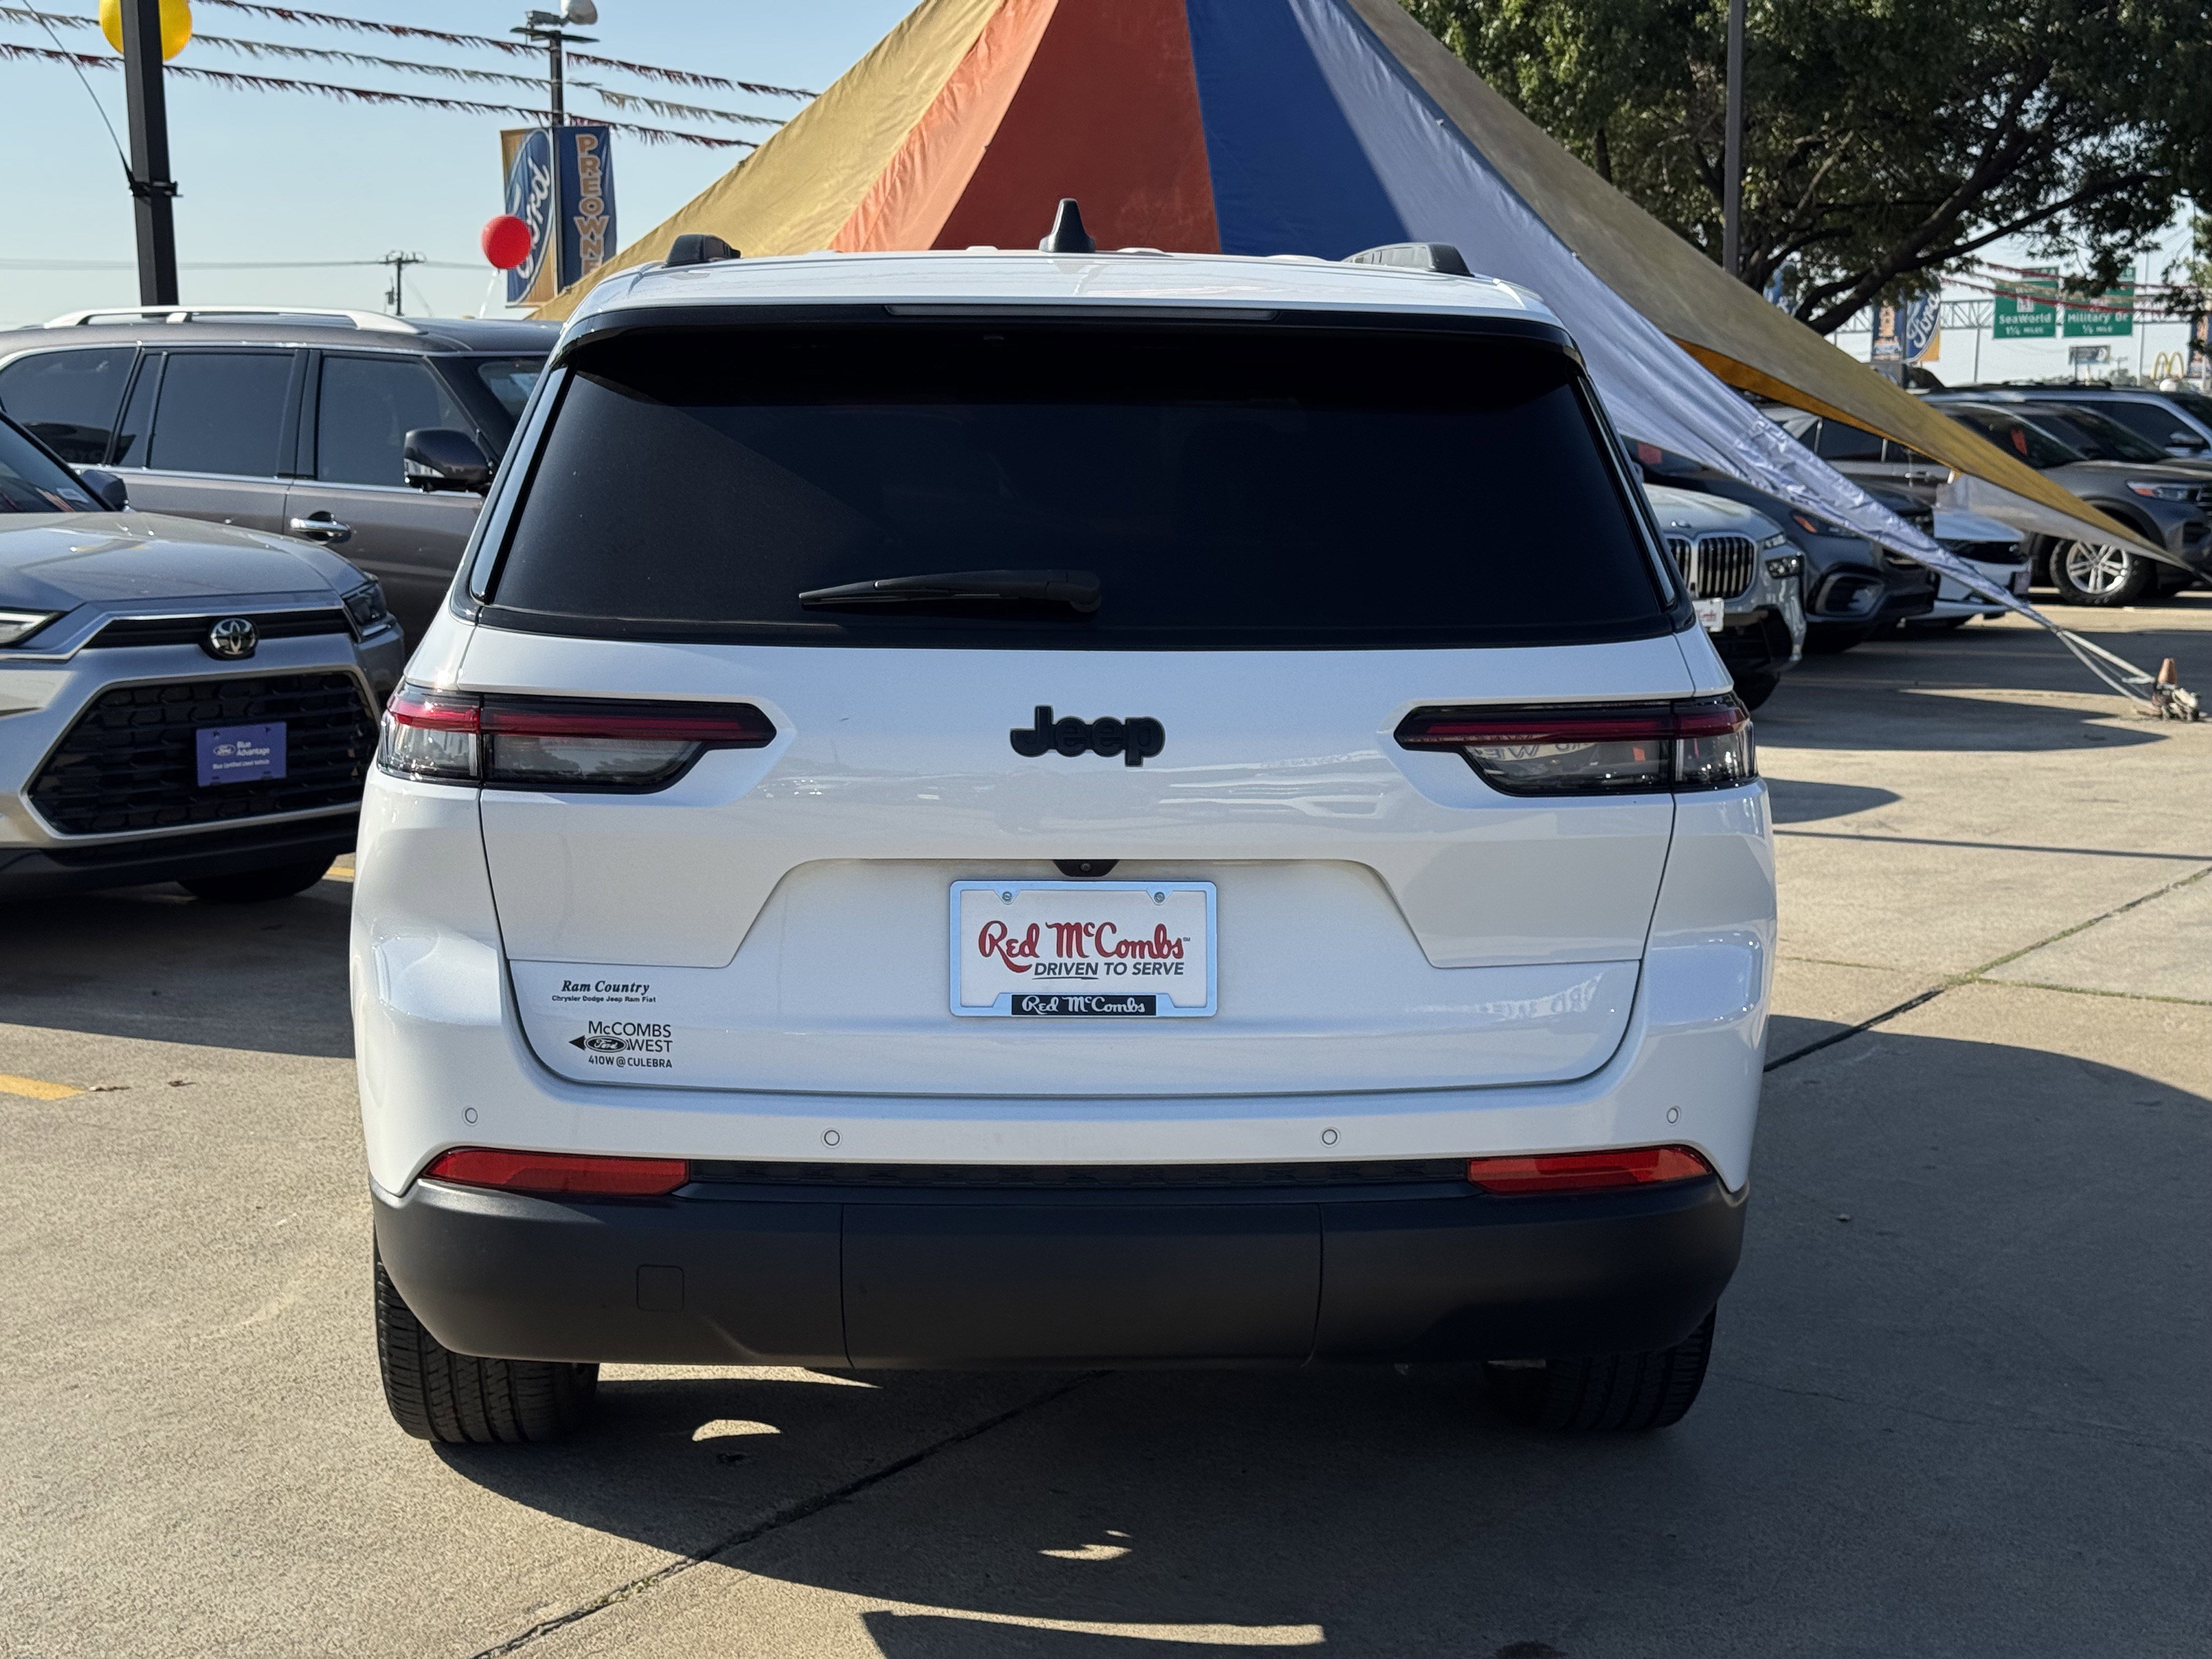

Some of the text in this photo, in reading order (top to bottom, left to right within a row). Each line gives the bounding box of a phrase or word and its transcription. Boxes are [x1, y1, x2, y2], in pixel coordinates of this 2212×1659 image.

[1999, 313, 2051, 324] SeaWorld
[2068, 312, 2111, 325] Military
[1009, 704, 1166, 768] Jeep
[978, 920, 1040, 973] Red
[1045, 921, 1184, 960] McCombs
[1034, 962, 1185, 975] DRIVEN TO SERVE
[561, 979, 650, 996] Ram Country
[551, 995, 581, 1003] Chrysler
[582, 995, 605, 1003] Dodge
[1021, 995, 1146, 1014] Red McCombs
[588, 1020, 672, 1038] McCOMBS
[629, 1038, 674, 1053] WEST
